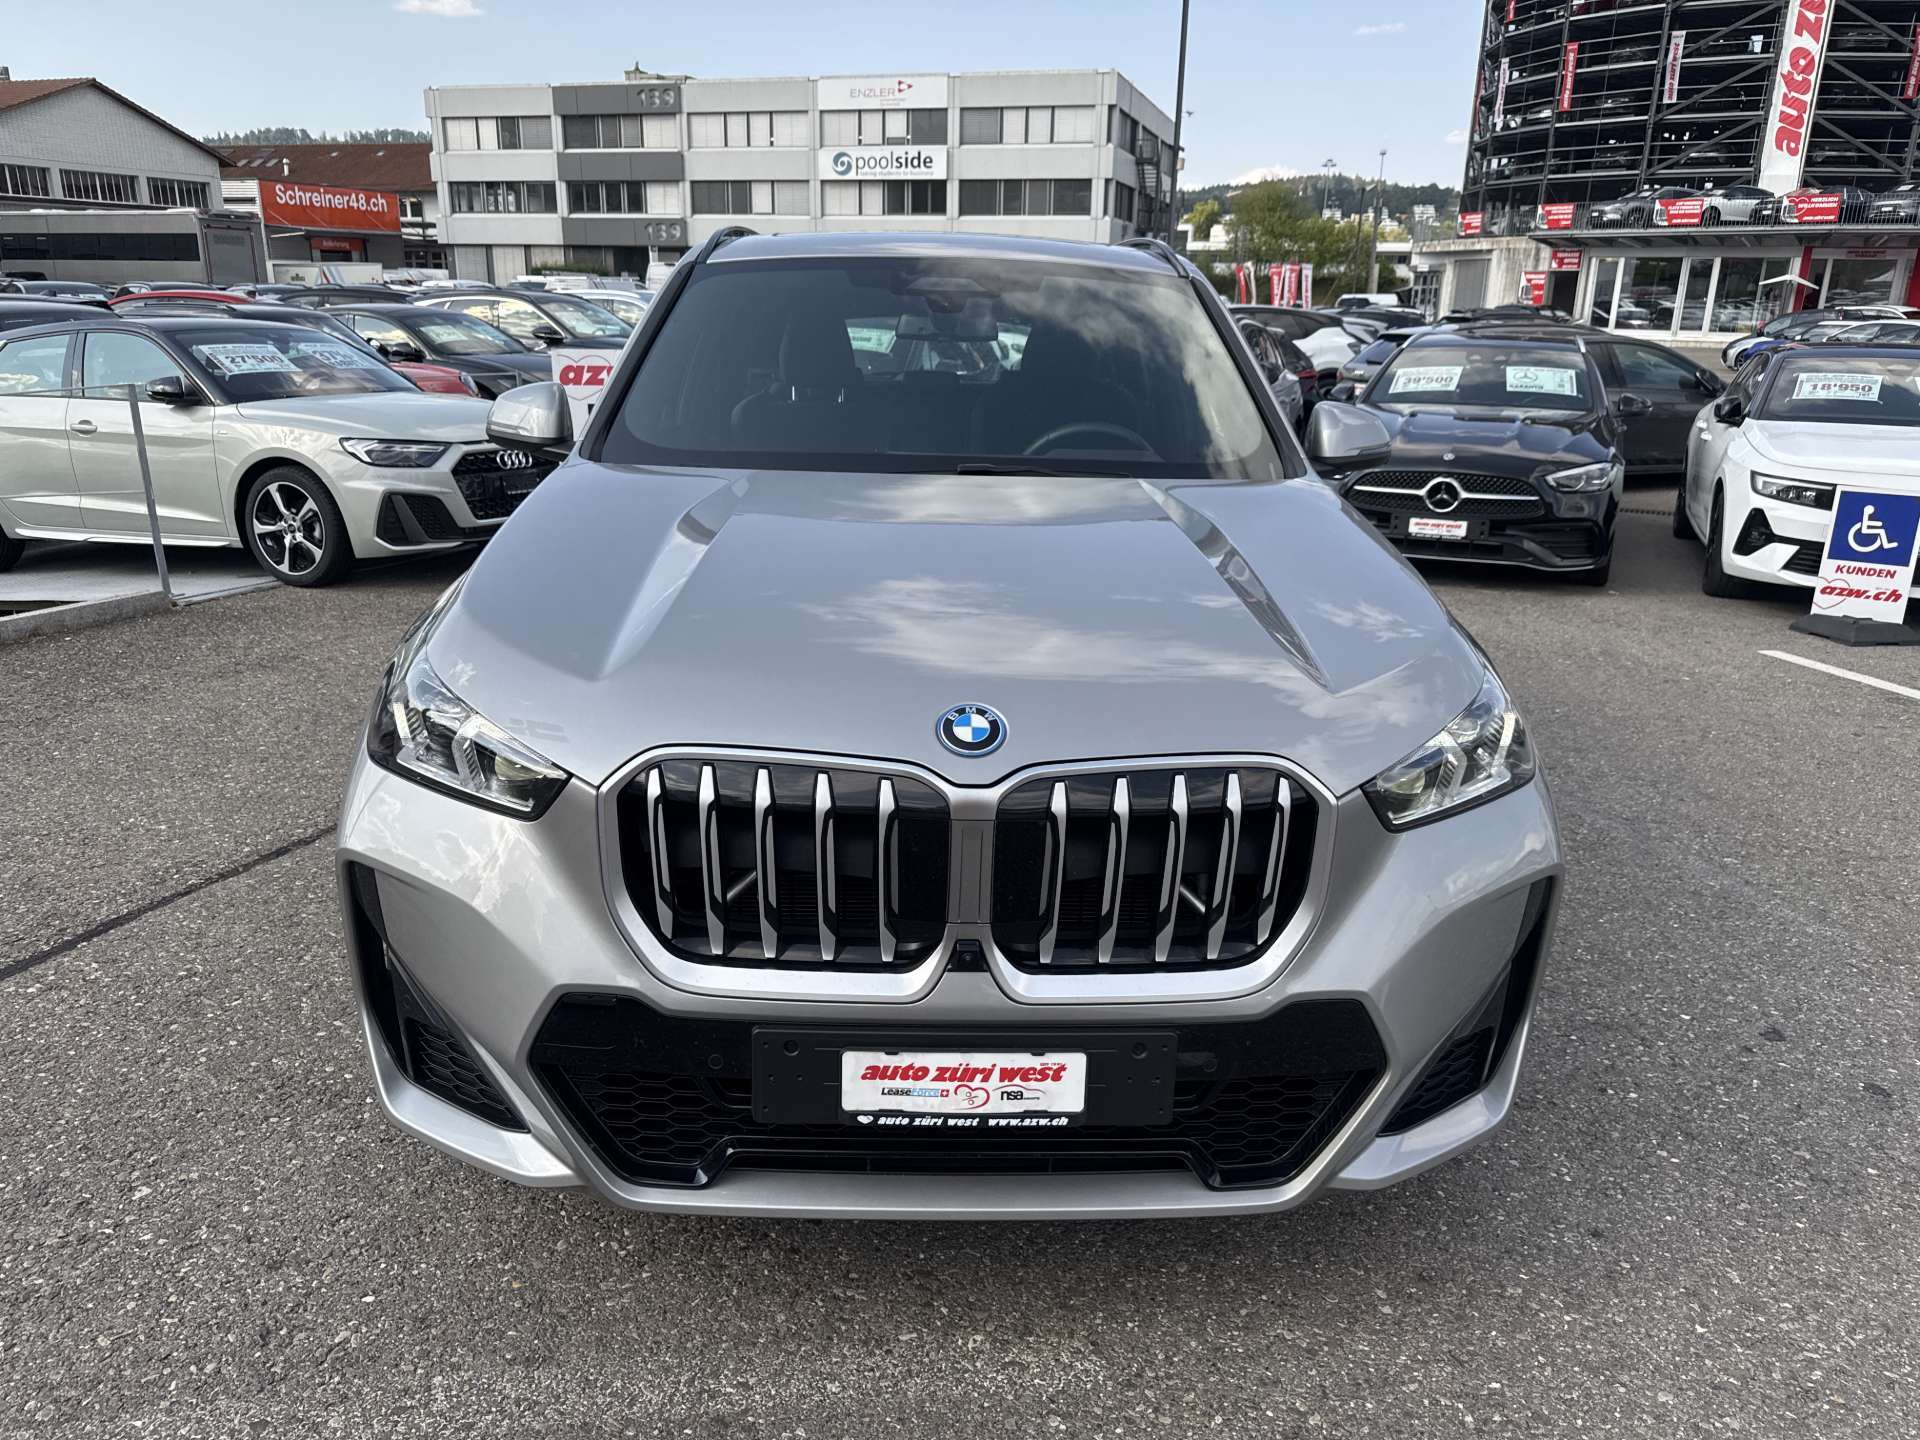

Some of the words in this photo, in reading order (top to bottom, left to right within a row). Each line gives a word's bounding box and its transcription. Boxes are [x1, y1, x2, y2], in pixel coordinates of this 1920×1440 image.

[636, 88, 675, 108] 139
[850, 87, 896, 98] ENZLER
[1775, 46, 1815, 157] auto
[855, 151, 934, 176] poolside
[275, 183, 388, 213] Schreiner48.ch
[644, 222, 682, 241] 139
[559, 365, 614, 386] az
[1810, 383, 1873, 393] 18'950
[1835, 564, 1897, 579] KUNDEN
[1820, 586, 1902, 602] azw.ch
[948, 705, 996, 721] BMW
[861, 1062, 930, 1081] auto
[931, 1063, 997, 1083] züri
[1000, 1063, 1068, 1083] west
[881, 1087, 940, 1097] LeaseForce
[1000, 1088, 1024, 1101] nsa
[878, 1115, 910, 1126] auto
[912, 1115, 944, 1126] züri
[947, 1117, 979, 1126] west
[988, 1116, 1069, 1126] www.azw.ch
